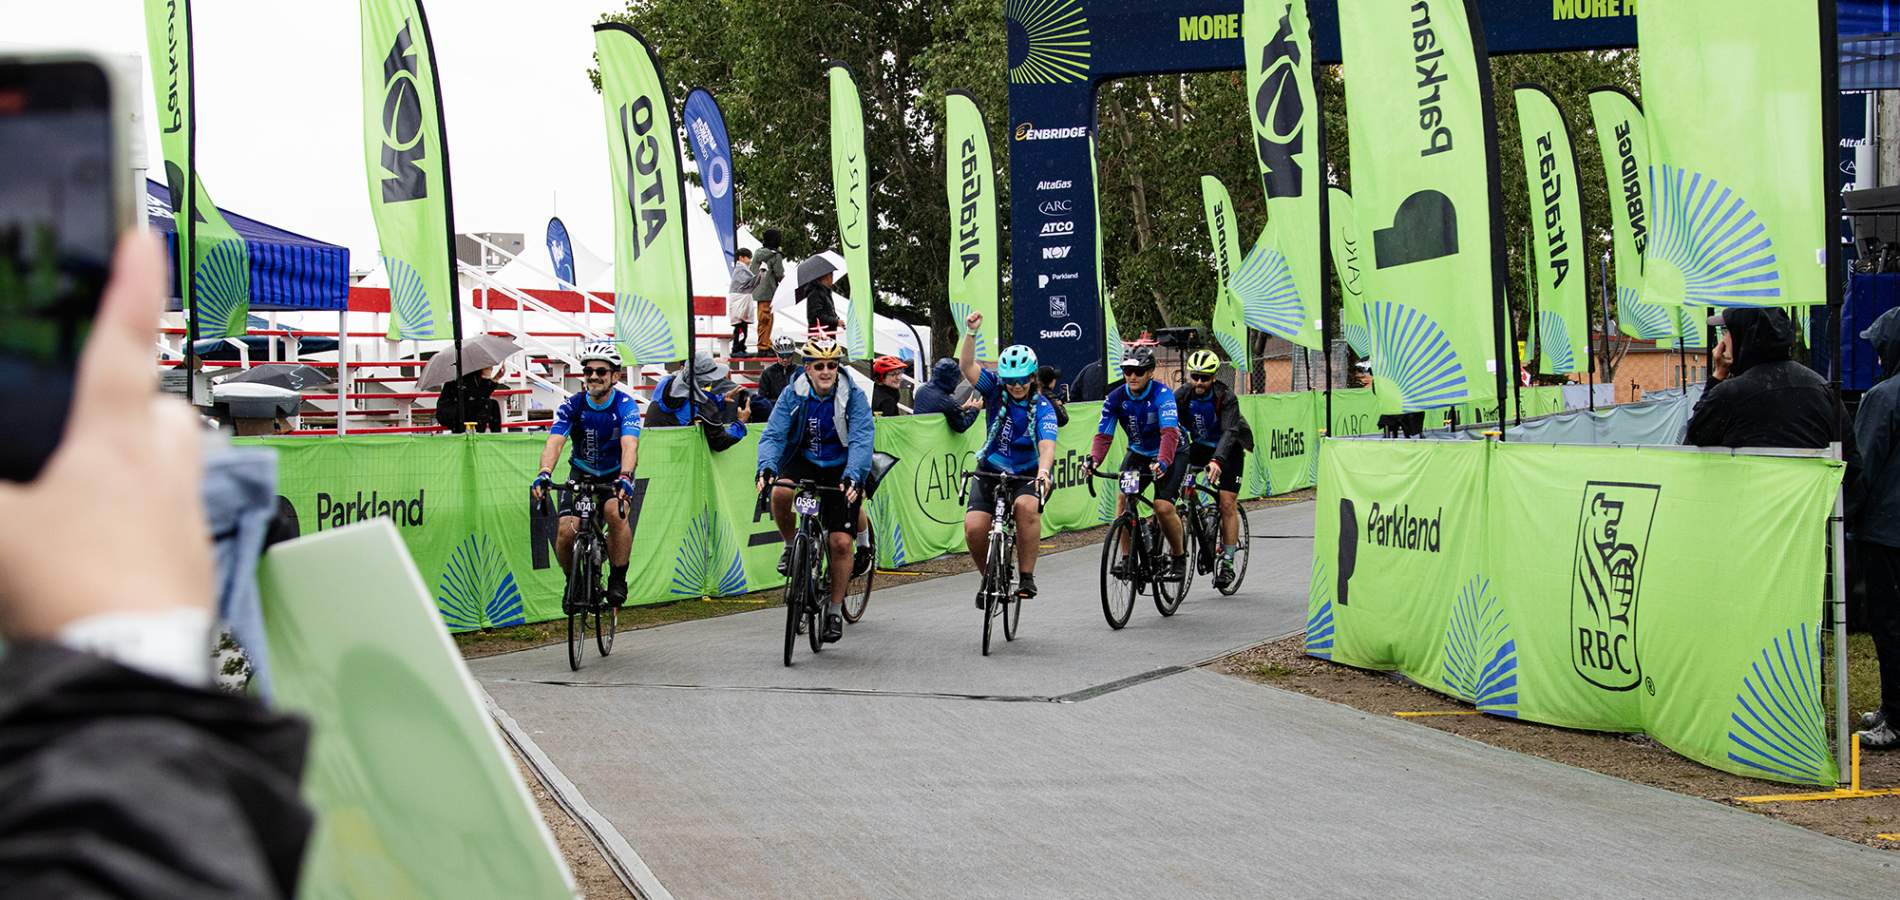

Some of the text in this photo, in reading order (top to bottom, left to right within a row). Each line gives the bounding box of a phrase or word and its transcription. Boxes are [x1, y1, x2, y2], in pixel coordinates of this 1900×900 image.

[1553, 0, 1619, 20] MORE
[1179, 14, 1238, 42] MORE
[1026, 126, 1087, 141] ENBRIDGE
[1036, 180, 1073, 191] AltaGas
[1044, 200, 1073, 213] ARC
[1041, 221, 1074, 233] ATCO
[1042, 246, 1072, 260] NOV
[1052, 272, 1079, 281] Parkland
[1270, 427, 1305, 460] AltaGas
[796, 496, 818, 509] 0583
[317, 489, 425, 532] Parkland
[1367, 501, 1442, 553] Parkland
[1578, 627, 1632, 675] RBC
